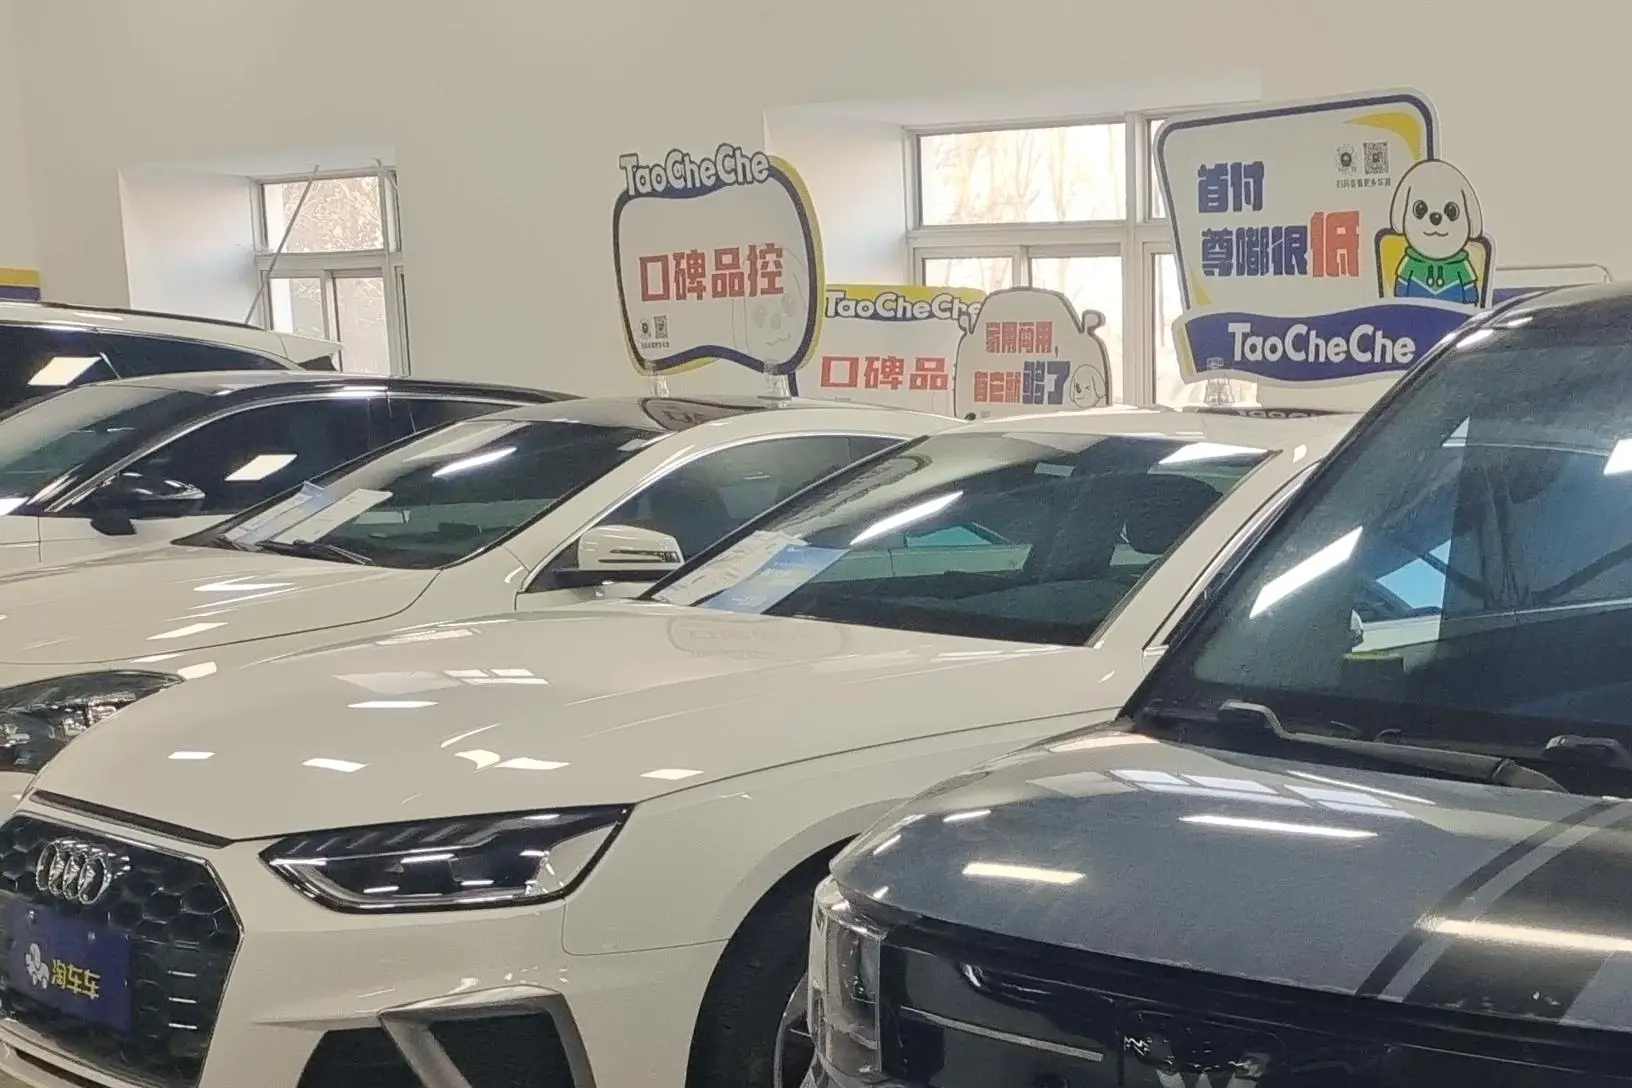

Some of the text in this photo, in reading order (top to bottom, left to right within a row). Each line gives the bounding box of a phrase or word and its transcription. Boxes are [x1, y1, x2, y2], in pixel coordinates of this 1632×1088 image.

[619, 143, 770, 195] TaoCheChe
[1197, 161, 1264, 213] 首付
[1201, 210, 1360, 278] 尊嘟很低
[638, 243, 784, 302] 口碑品控
[1228, 322, 1416, 364] TaoCheChe
[820, 355, 949, 390] 口碑品
[51, 958, 101, 1000] 淘车车
